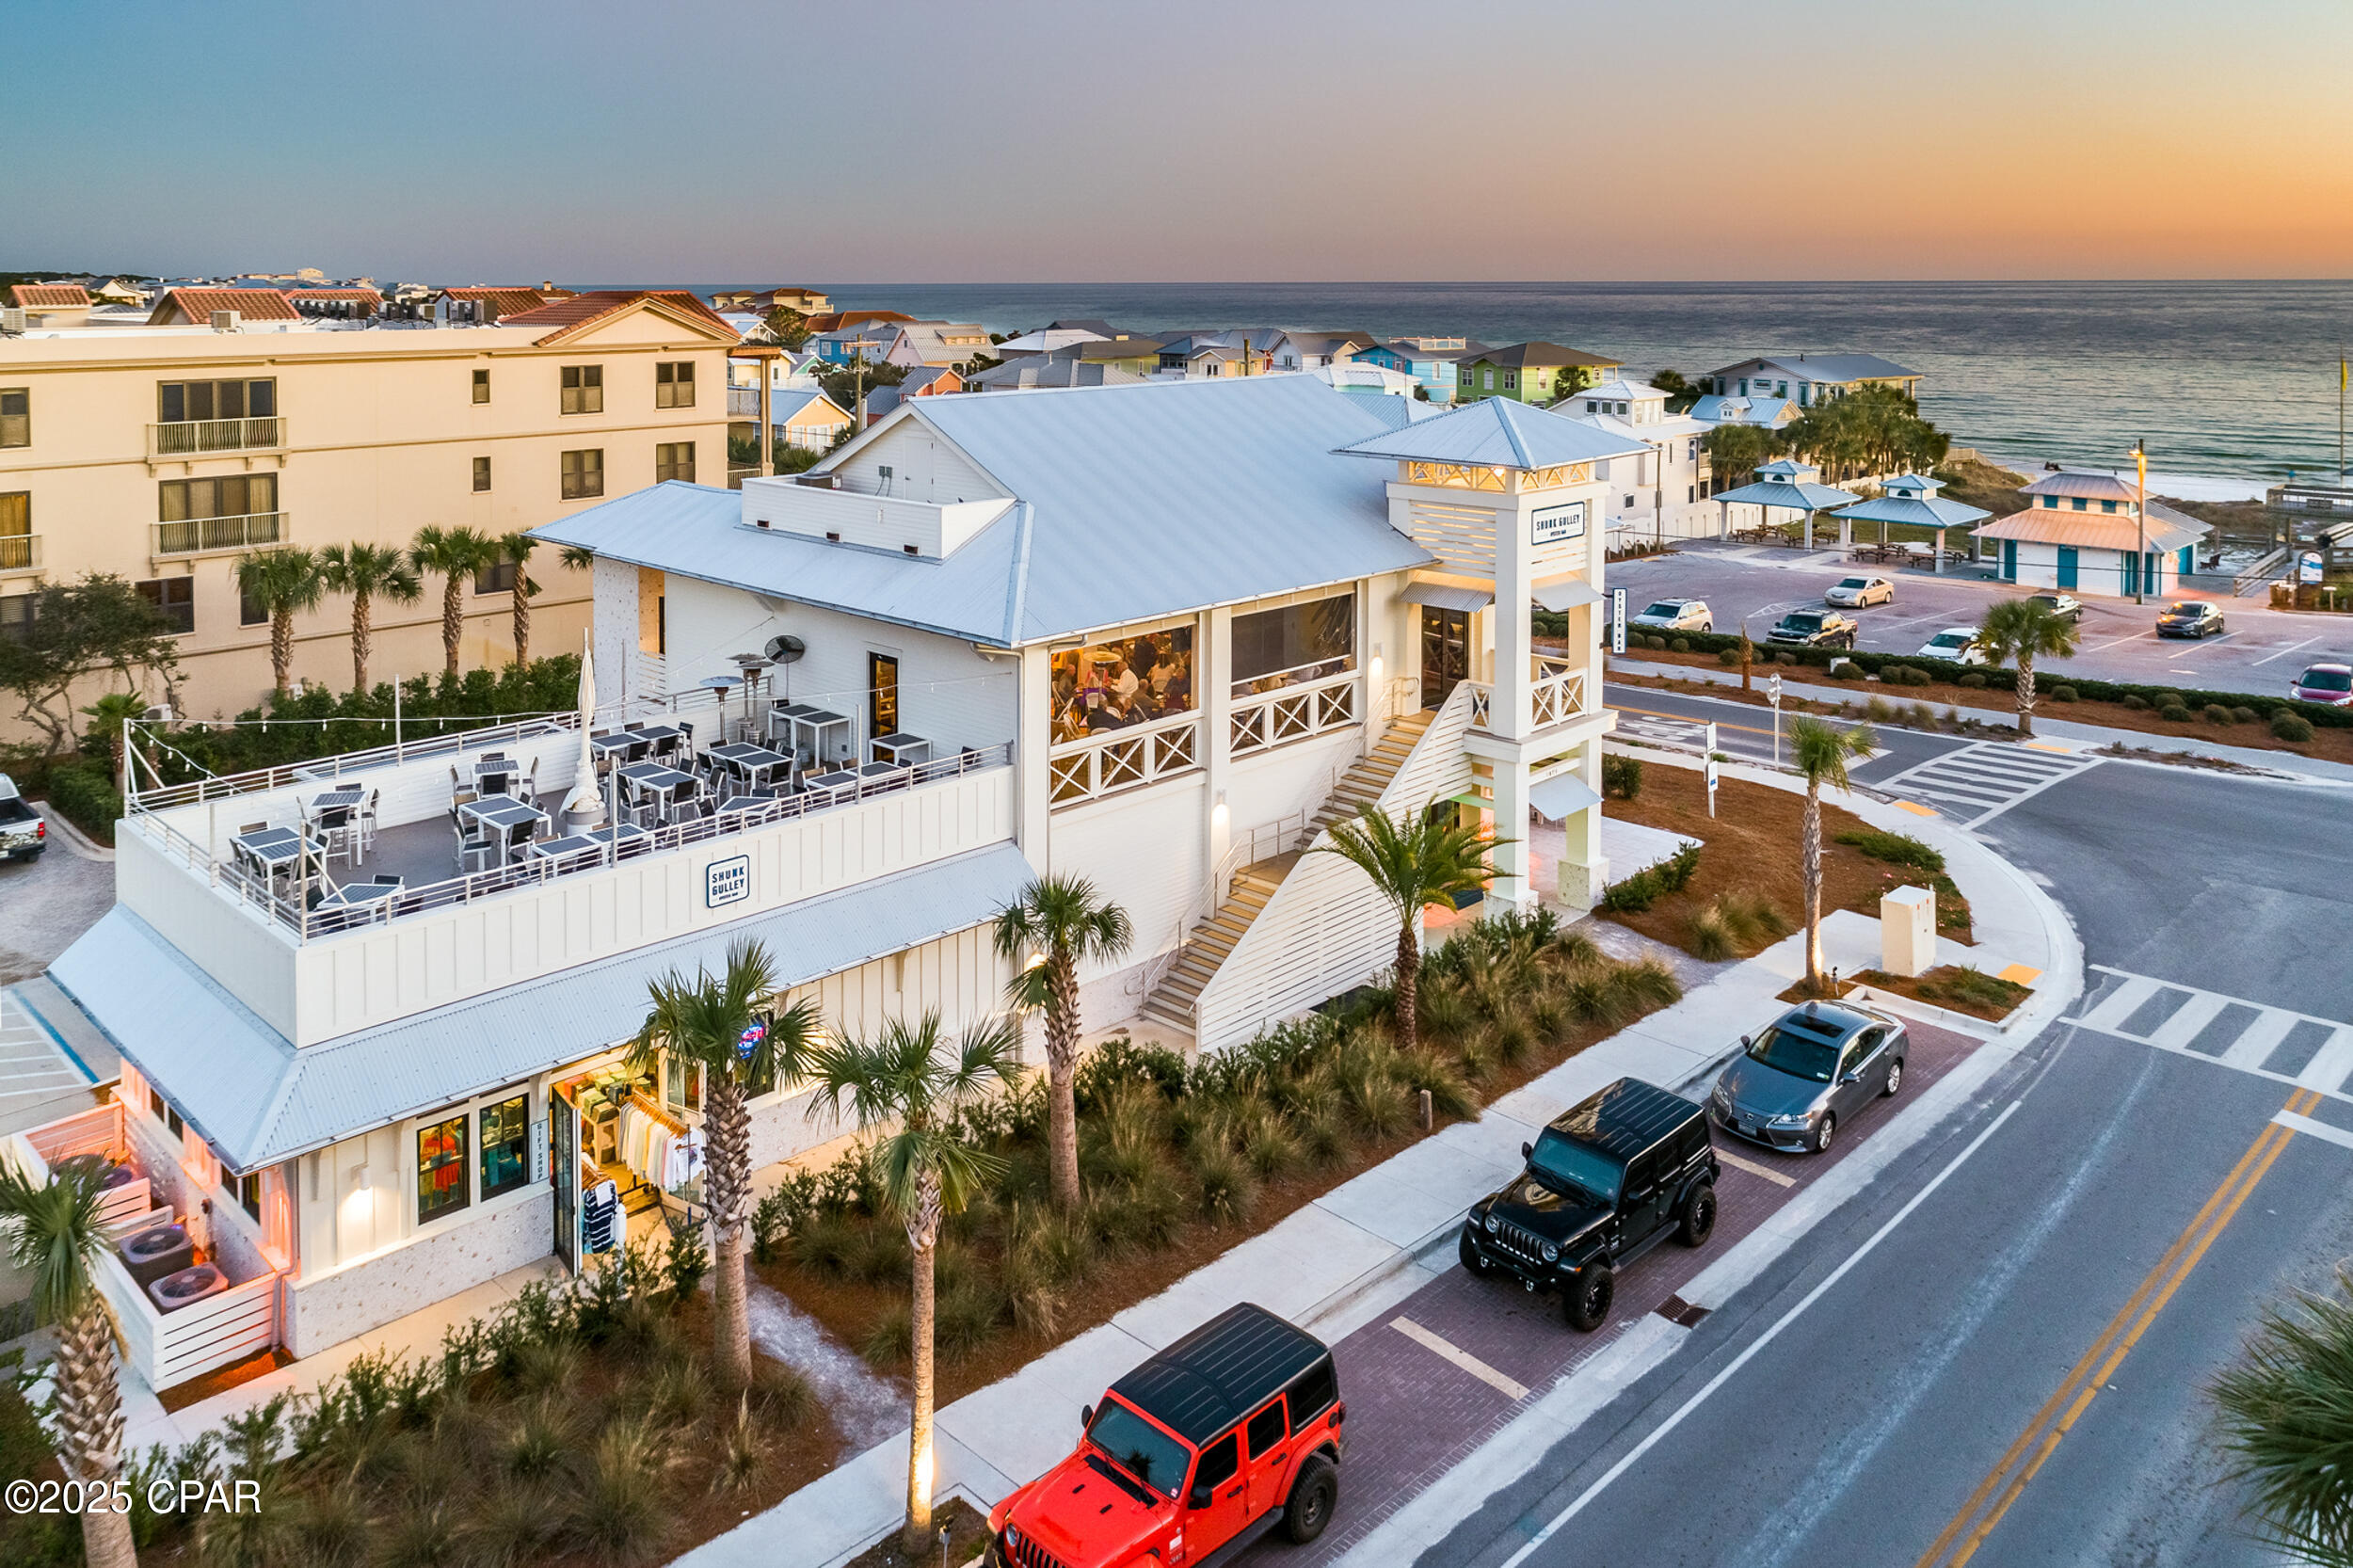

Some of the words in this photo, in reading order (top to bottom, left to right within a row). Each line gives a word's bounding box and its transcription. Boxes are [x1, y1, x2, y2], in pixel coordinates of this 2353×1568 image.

[1536, 518, 1557, 531] SHUNK
[1559, 514, 1579, 527] GULLEY
[712, 866, 744, 883] SHUNK
[712, 878, 744, 896] GULLEY
